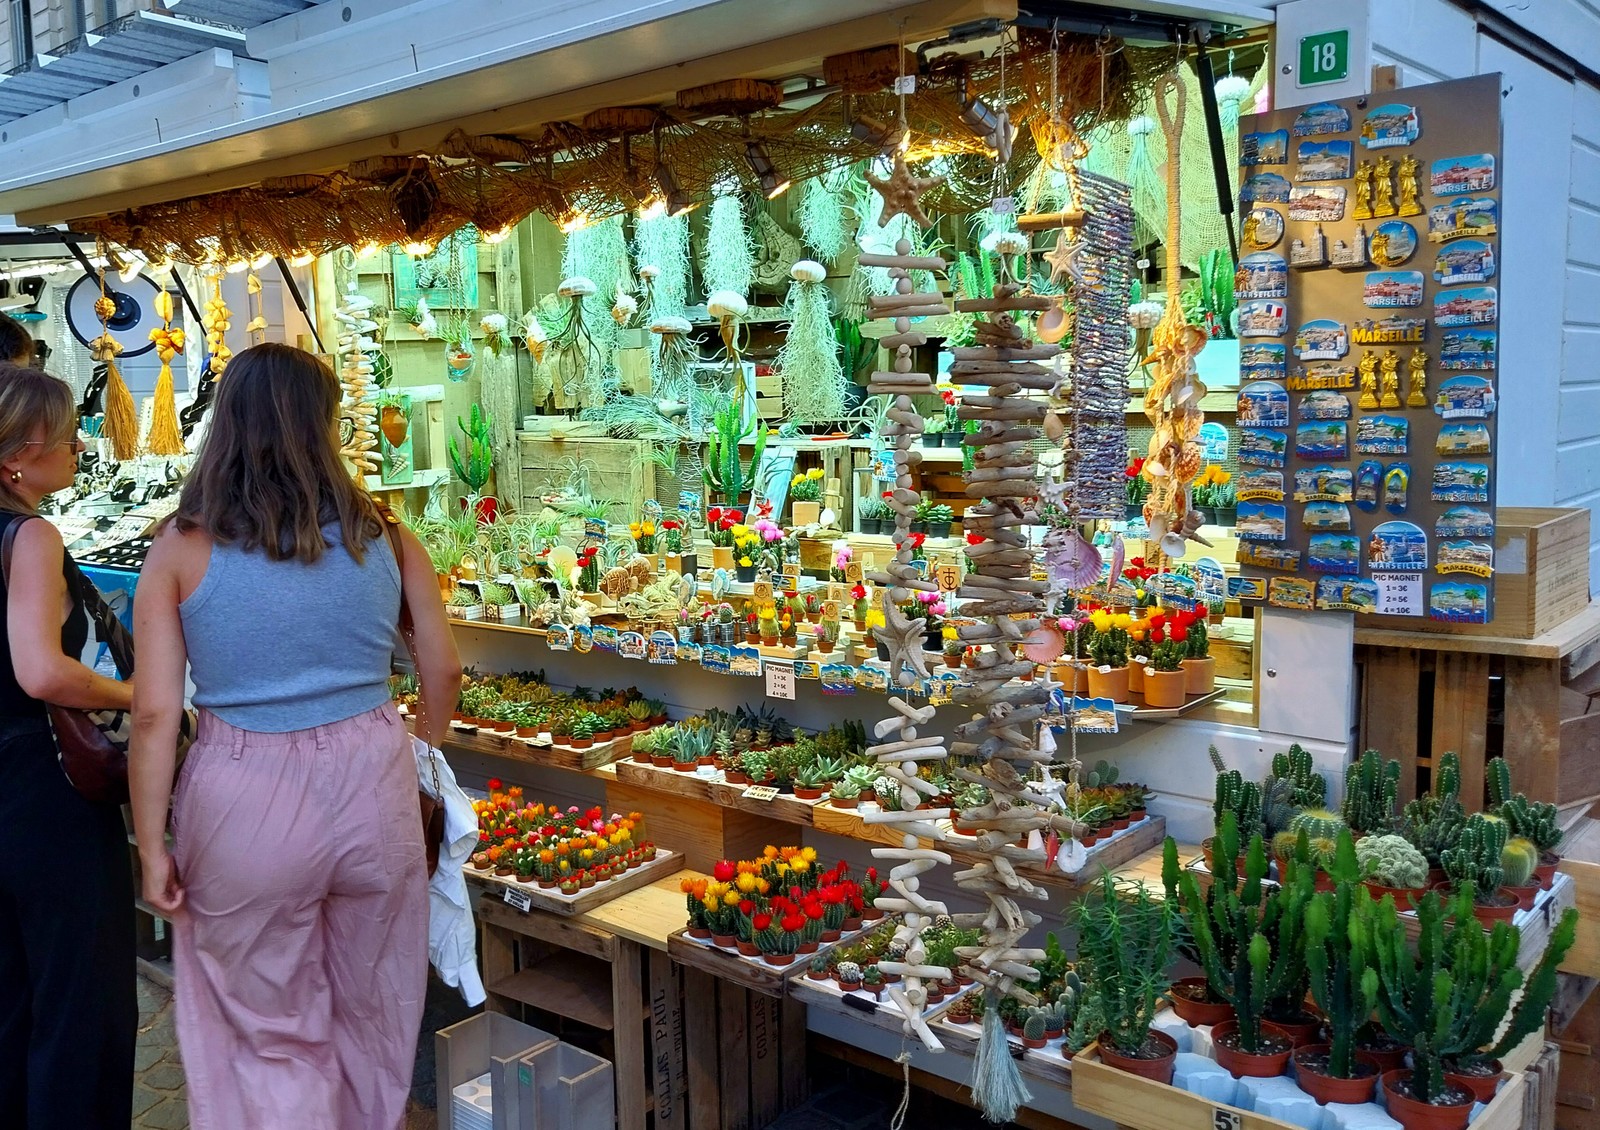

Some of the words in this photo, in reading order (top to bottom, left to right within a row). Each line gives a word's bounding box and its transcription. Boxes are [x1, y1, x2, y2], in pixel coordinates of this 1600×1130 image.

[1311, 42, 1337, 73] 18
[1369, 136, 1409, 148] MARSEILLE
[1433, 182, 1489, 195] MARSEILLE
[1441, 229, 1479, 240] MARSEILLE
[1236, 291, 1281, 299] MARSEILLE
[1365, 298, 1416, 307] MARSEILLE
[1436, 314, 1492, 326] MARSEILLE
[1351, 326, 1424, 343] MARSEILLE
[1287, 374, 1355, 391] MARSEILLE
[1444, 408, 1485, 418] MARSEILLE
[1242, 491, 1279, 499] MARSEILLE
[1235, 532, 1284, 540] MARSEILLE
[1371, 561, 1421, 570] MARSEILLE
[1443, 565, 1487, 576] MARSEILLE
[1388, 574, 1420, 582] MAGNET
[775, 666, 794, 675] MAGNET
[654, 988, 668, 1043] PAUL
[754, 997, 768, 1060] COLLAS
[657, 1052, 673, 1120] COLLAS
